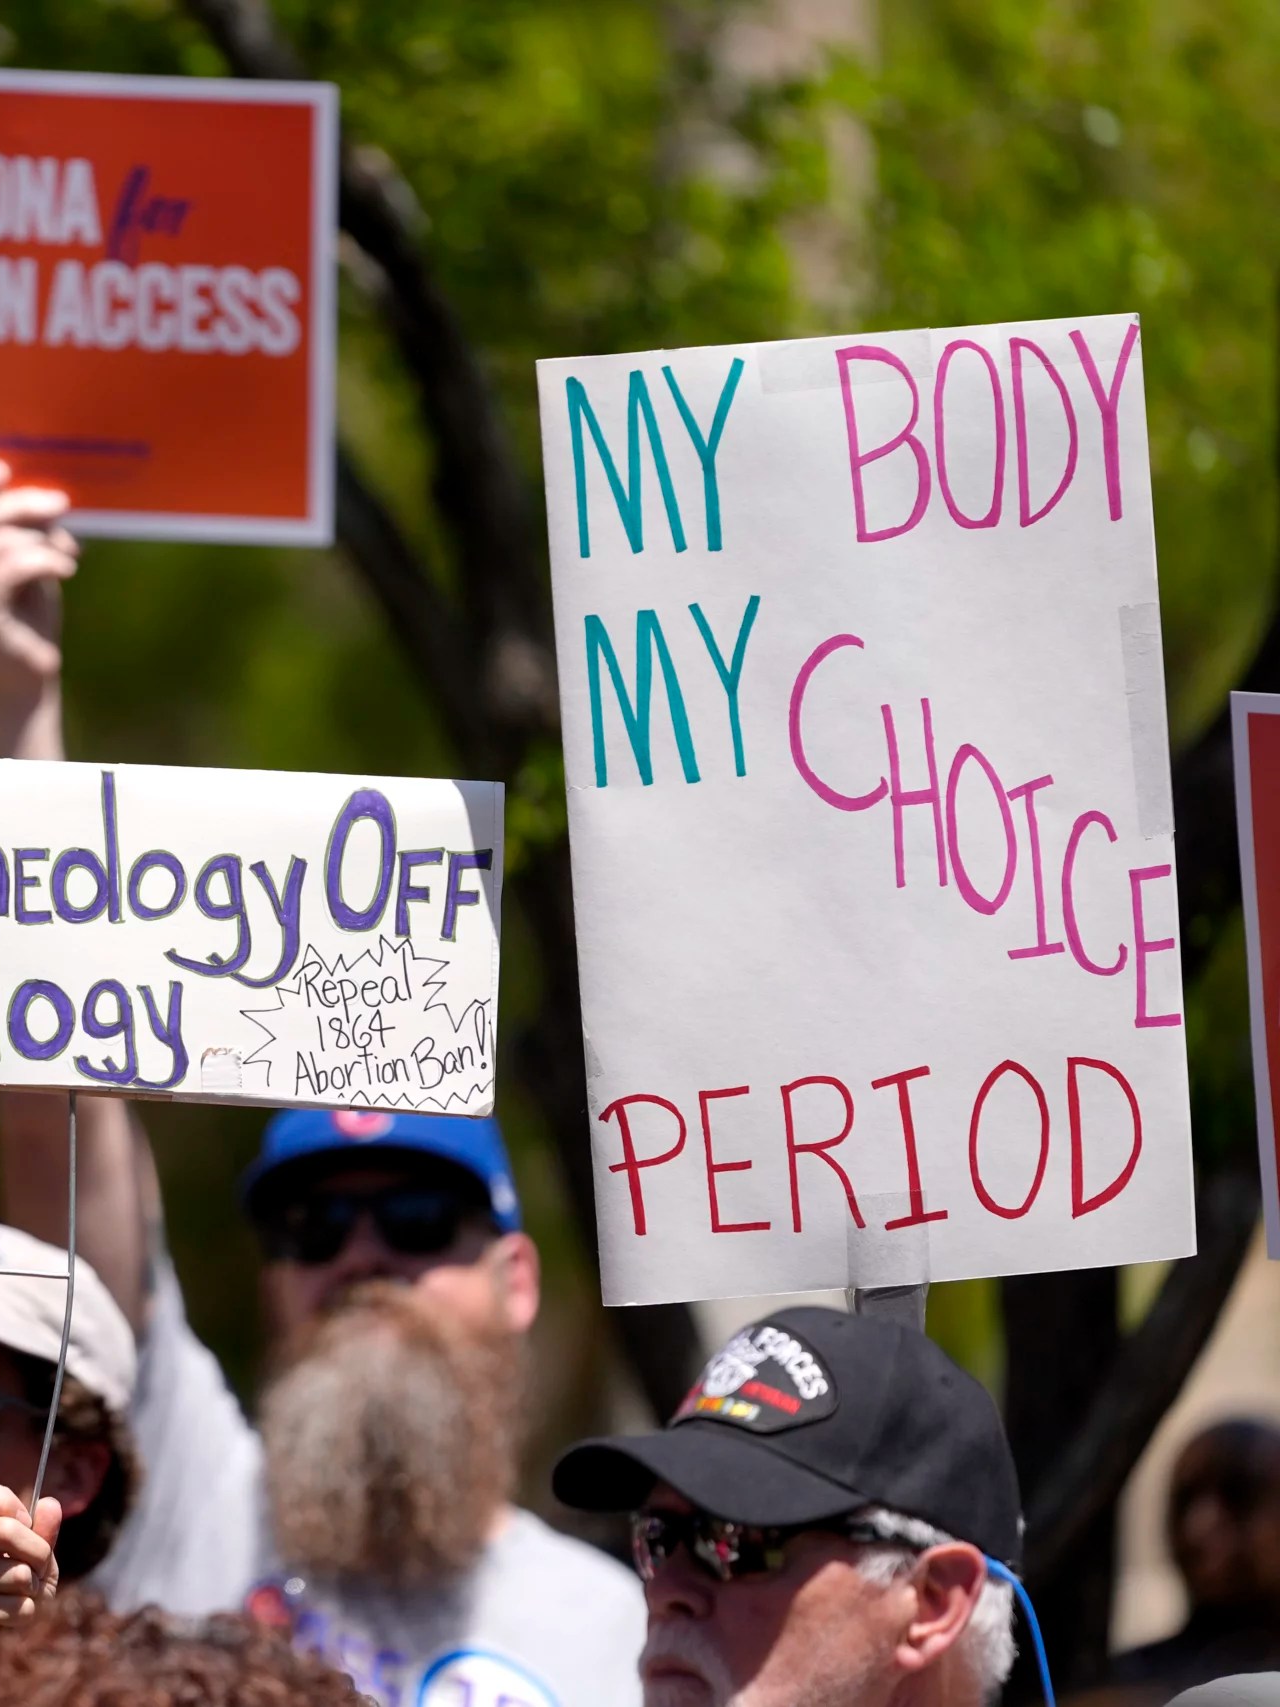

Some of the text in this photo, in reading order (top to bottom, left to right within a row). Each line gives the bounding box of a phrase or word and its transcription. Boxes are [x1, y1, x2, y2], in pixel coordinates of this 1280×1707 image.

[106, 163, 191, 263] for
[44, 258, 301, 357] ACCESS
[565, 322, 1140, 558] MY BODY
[584, 594, 1182, 1029] MY CHOICE
[324, 787, 493, 942] OFF
[292, 947, 412, 1024] Repeal
[317, 1009, 396, 1052] 1864
[294, 1006, 488, 1096] Abortion Ban!
[599, 1055, 1143, 1236] PERIOD
[753, 1326, 829, 1400] FORCES
